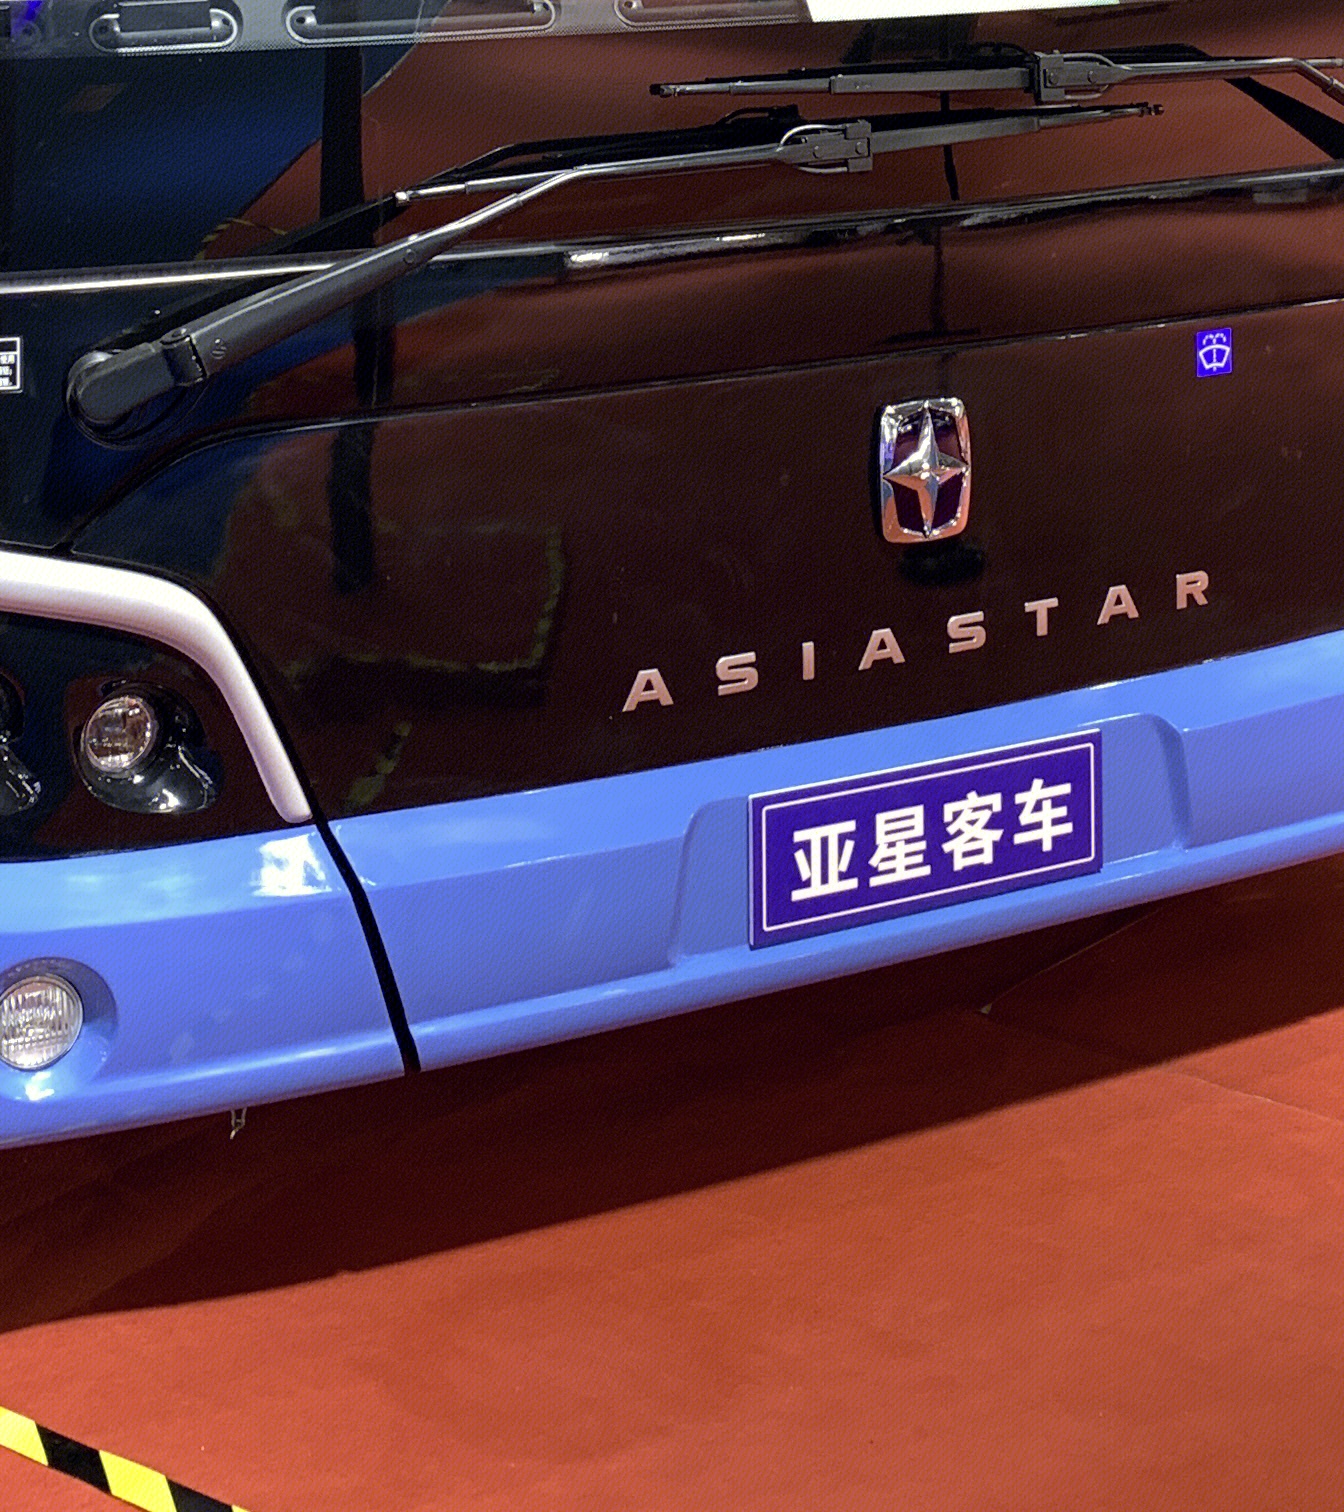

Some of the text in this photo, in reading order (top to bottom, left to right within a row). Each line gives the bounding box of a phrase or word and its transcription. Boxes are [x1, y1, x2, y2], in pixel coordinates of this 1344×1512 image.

[622, 569, 1210, 713] ASIASTAR
[790, 778, 1074, 902] 亚星客车
